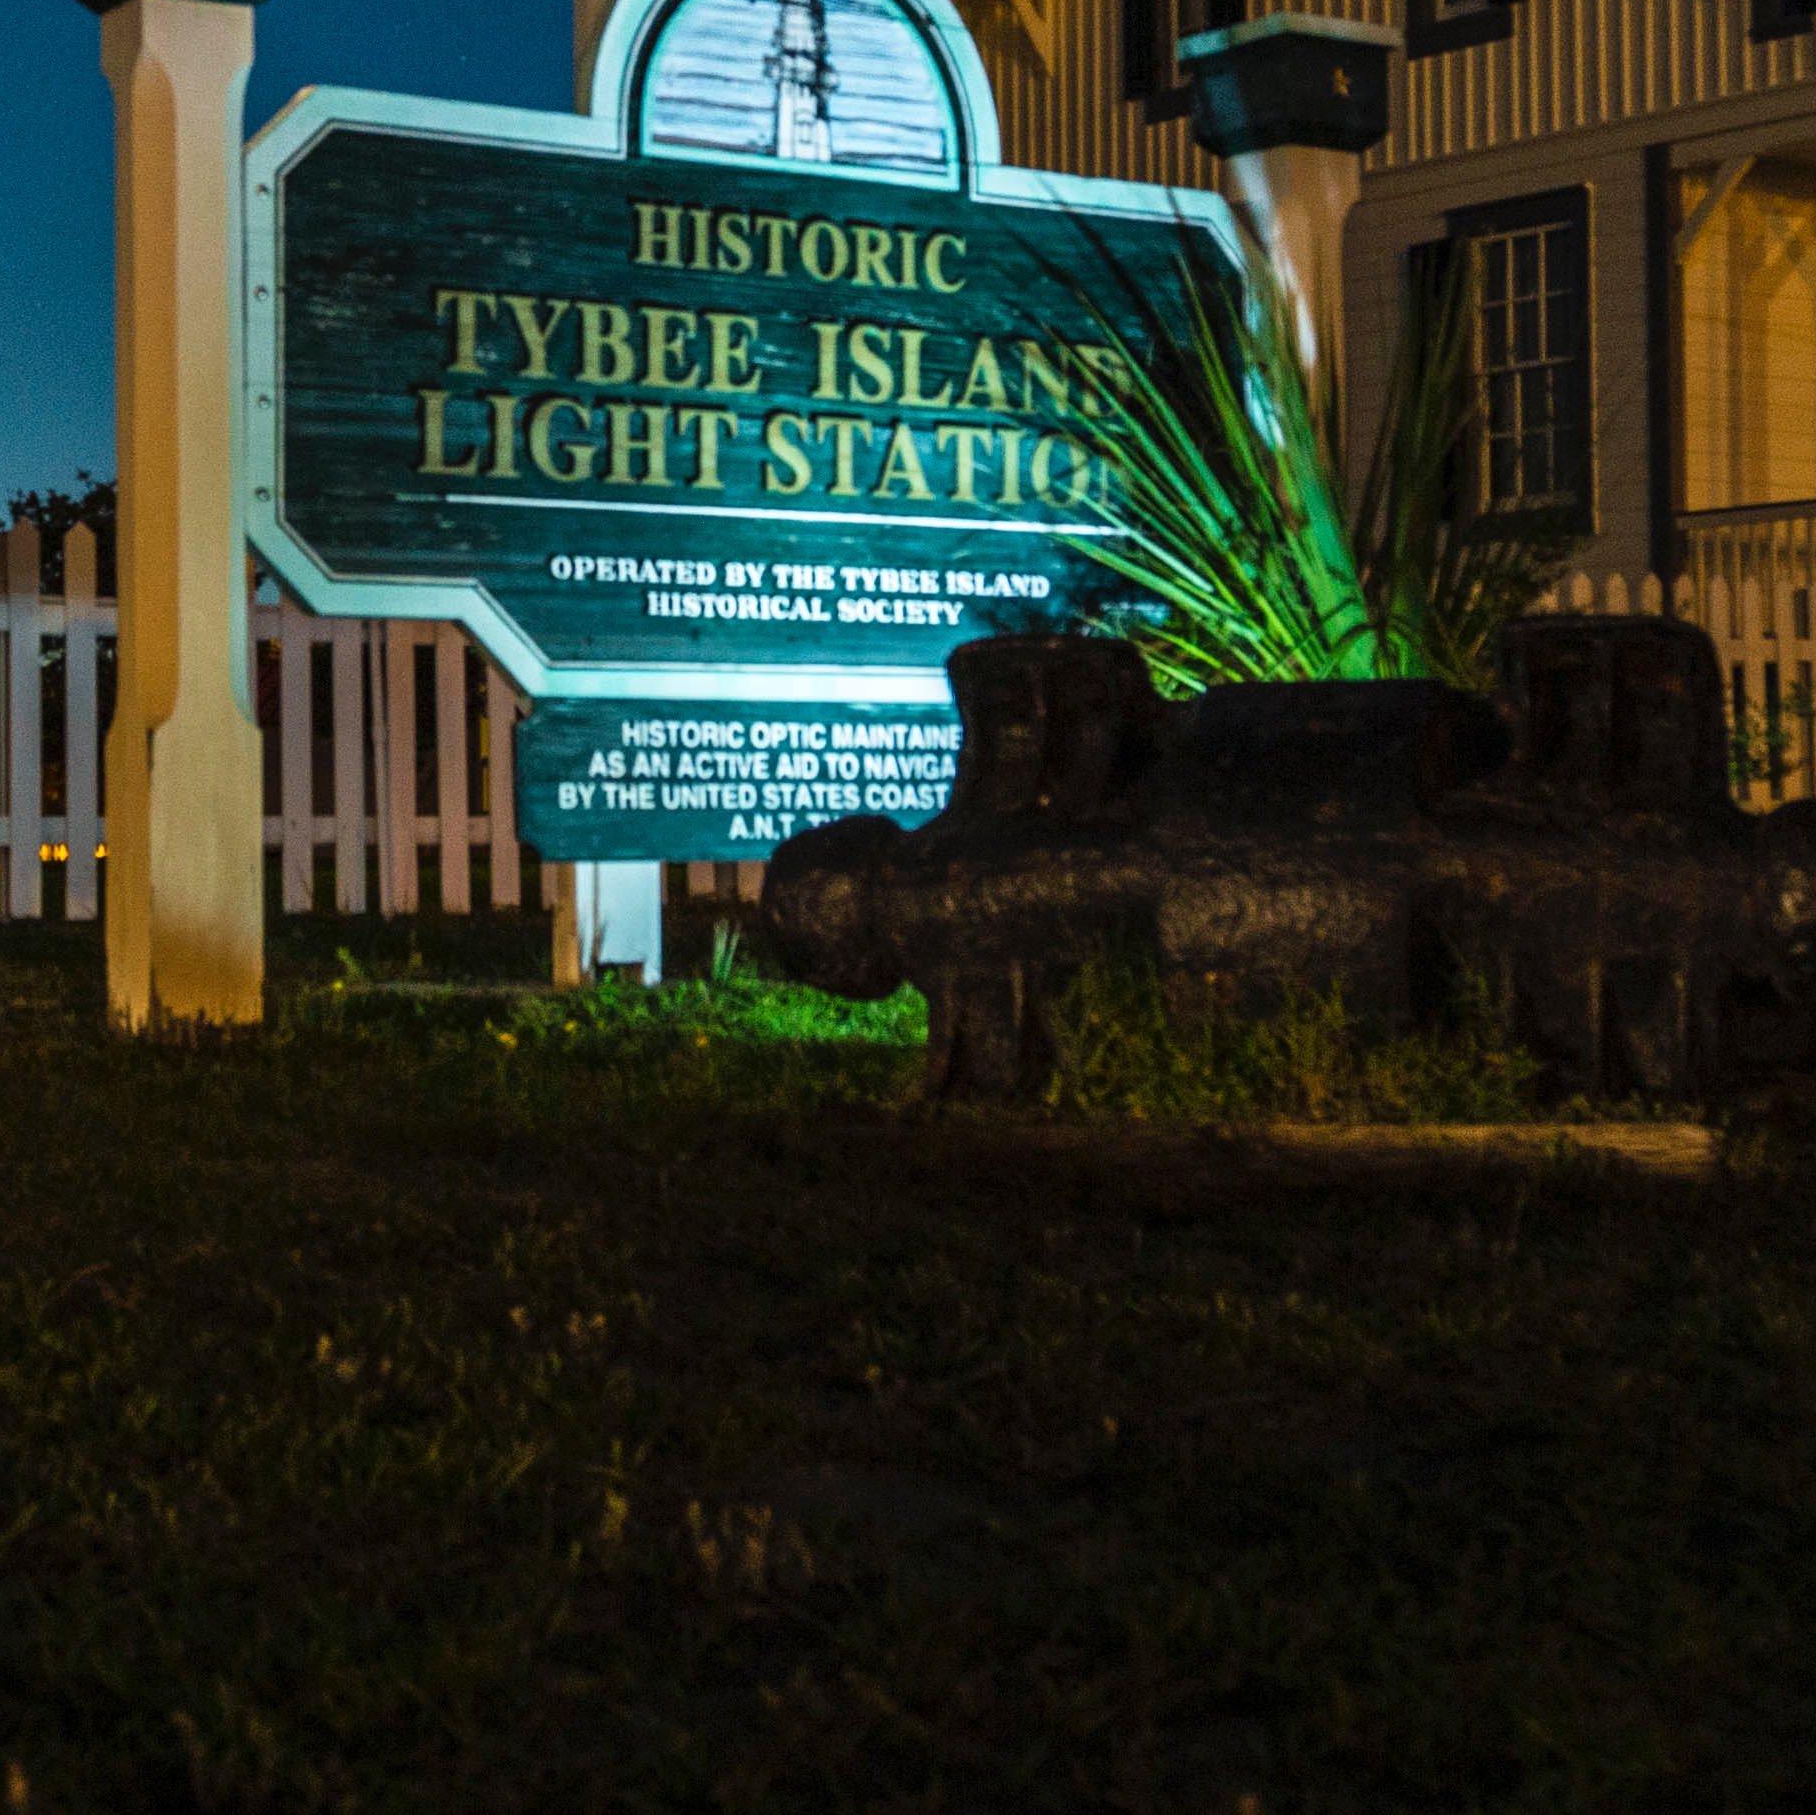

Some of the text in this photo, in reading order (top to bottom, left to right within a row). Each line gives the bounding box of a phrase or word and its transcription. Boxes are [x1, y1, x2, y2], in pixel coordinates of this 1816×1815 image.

[634, 202, 966, 294] HISTORIC
[436, 289, 762, 394] TYBEE
[417, 390, 739, 490] LIGHT
[550, 555, 1050, 599] OPERATED BY THE TYBEE ISLAND
[647, 591, 964, 625] HISTORICAL SOCIETY
[621, 719, 745, 749] HISTORIC
[749, 721, 827, 750] OPTIC
[588, 749, 626, 779] AS
[632, 751, 671, 779] AN
[677, 751, 770, 780] ACTIVE
[775, 752, 820, 780] AID
[823, 752, 860, 780] TO
[558, 781, 950, 811] BY THE UNITED STATES COAST
